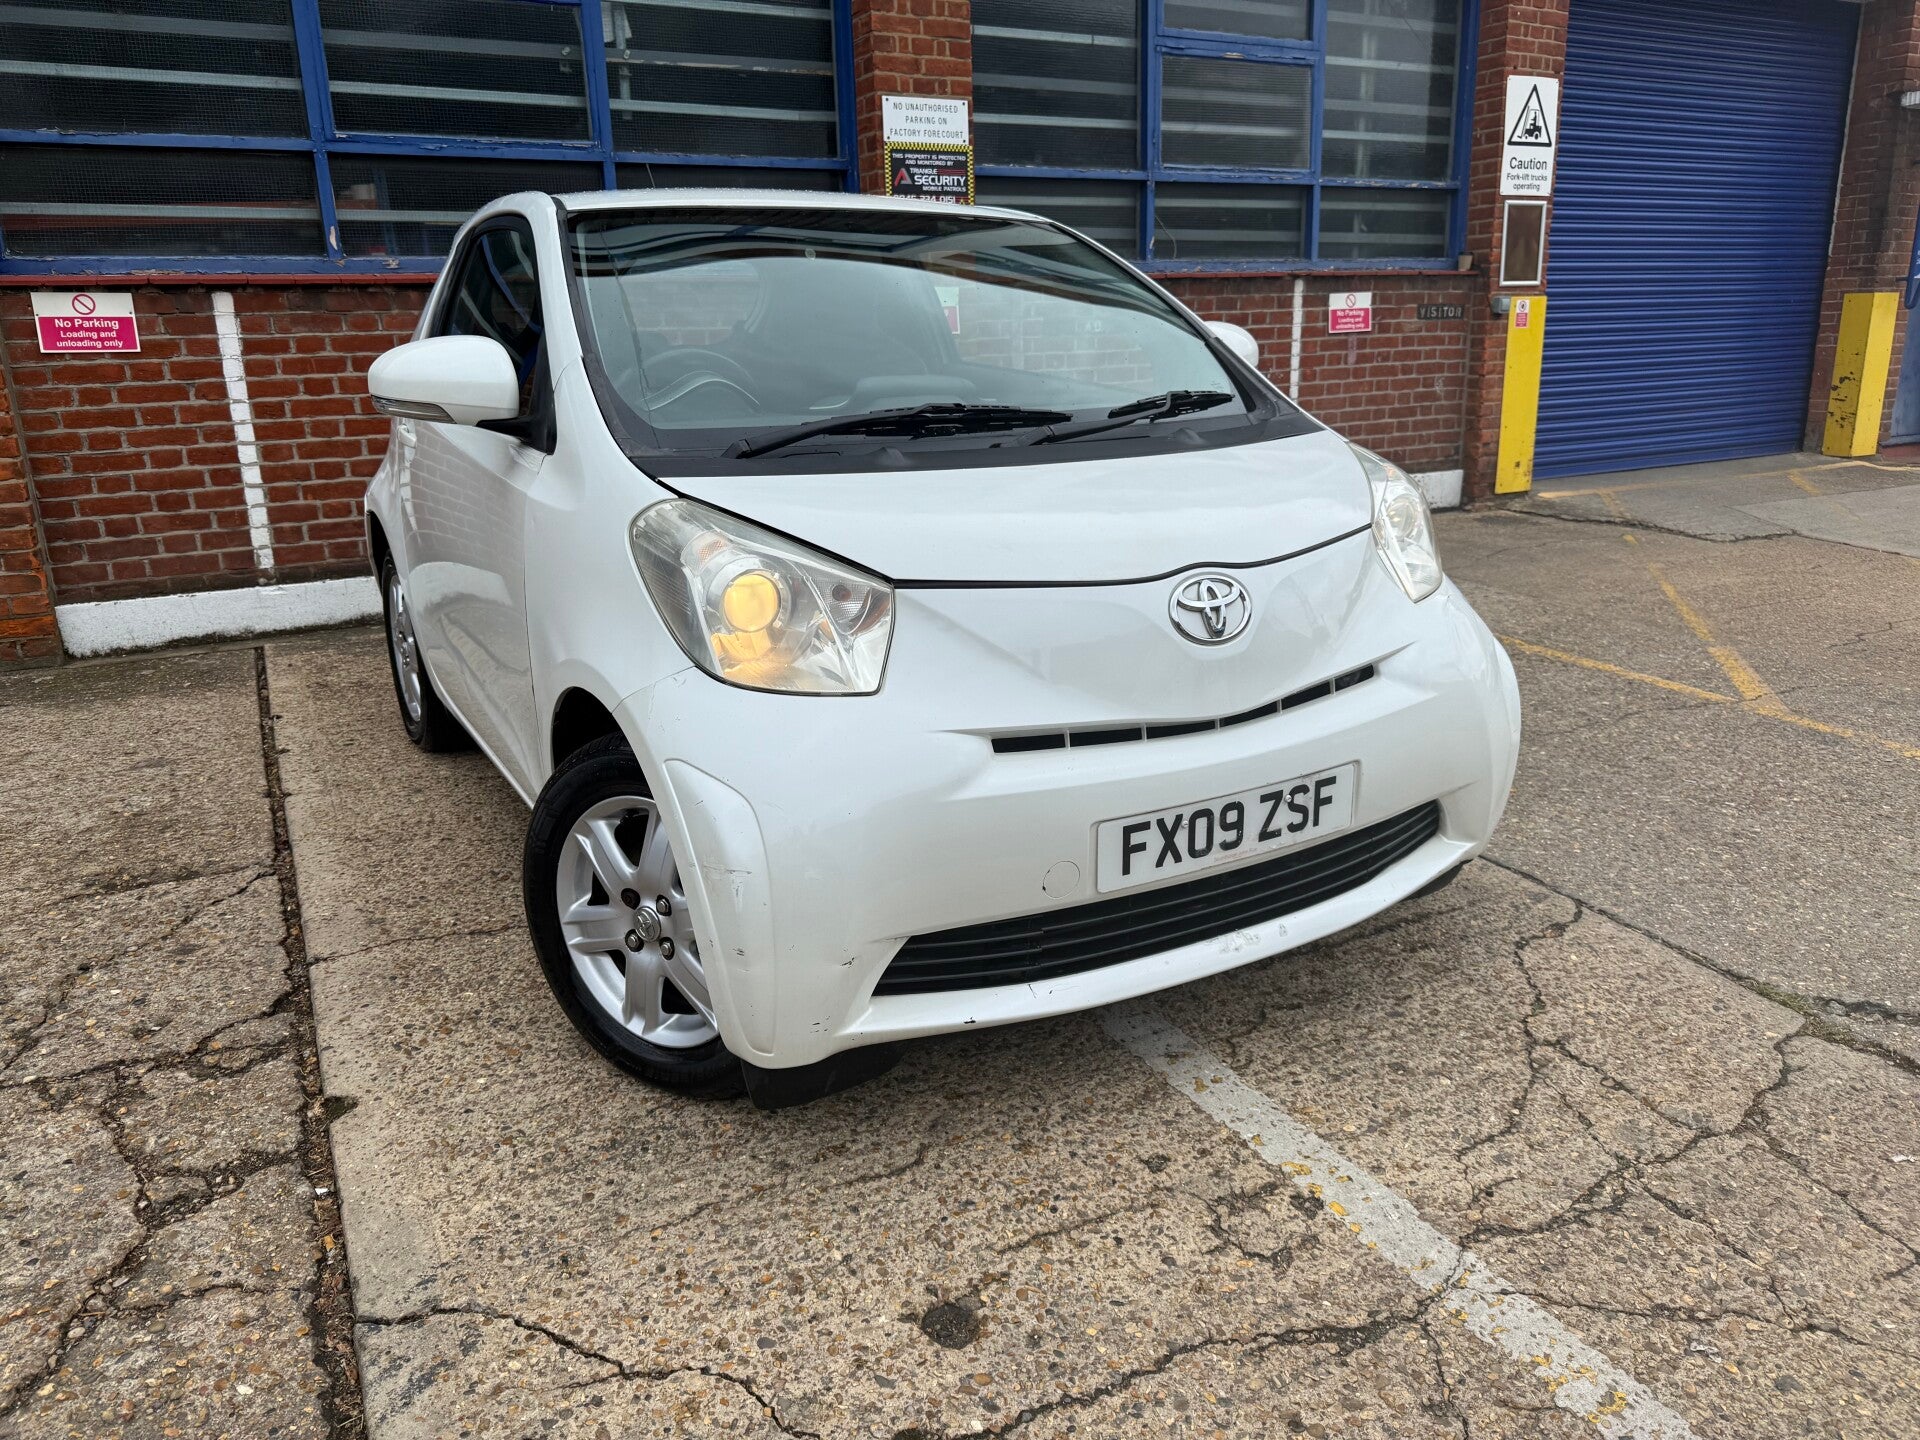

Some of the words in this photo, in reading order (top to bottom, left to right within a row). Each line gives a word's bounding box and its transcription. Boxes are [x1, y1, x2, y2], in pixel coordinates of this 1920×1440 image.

[905, 103, 958, 113] UNAUTHORISED
[906, 116, 935, 124] PARKING
[890, 129, 920, 137] FACTORY
[924, 130, 963, 138] FORECOURT
[1510, 157, 1547, 170] Caution
[914, 175, 966, 186] SECURITY
[1513, 183, 1540, 191] operating
[1420, 307, 1461, 318] VISITOR
[55, 319, 71, 327] No
[75, 319, 119, 329] Parking
[61, 331, 97, 339] Loading
[57, 340, 102, 348] unloading
[104, 340, 123, 348] only
[1122, 801, 1244, 875] FX09
[1258, 776, 1336, 842] ZSF
